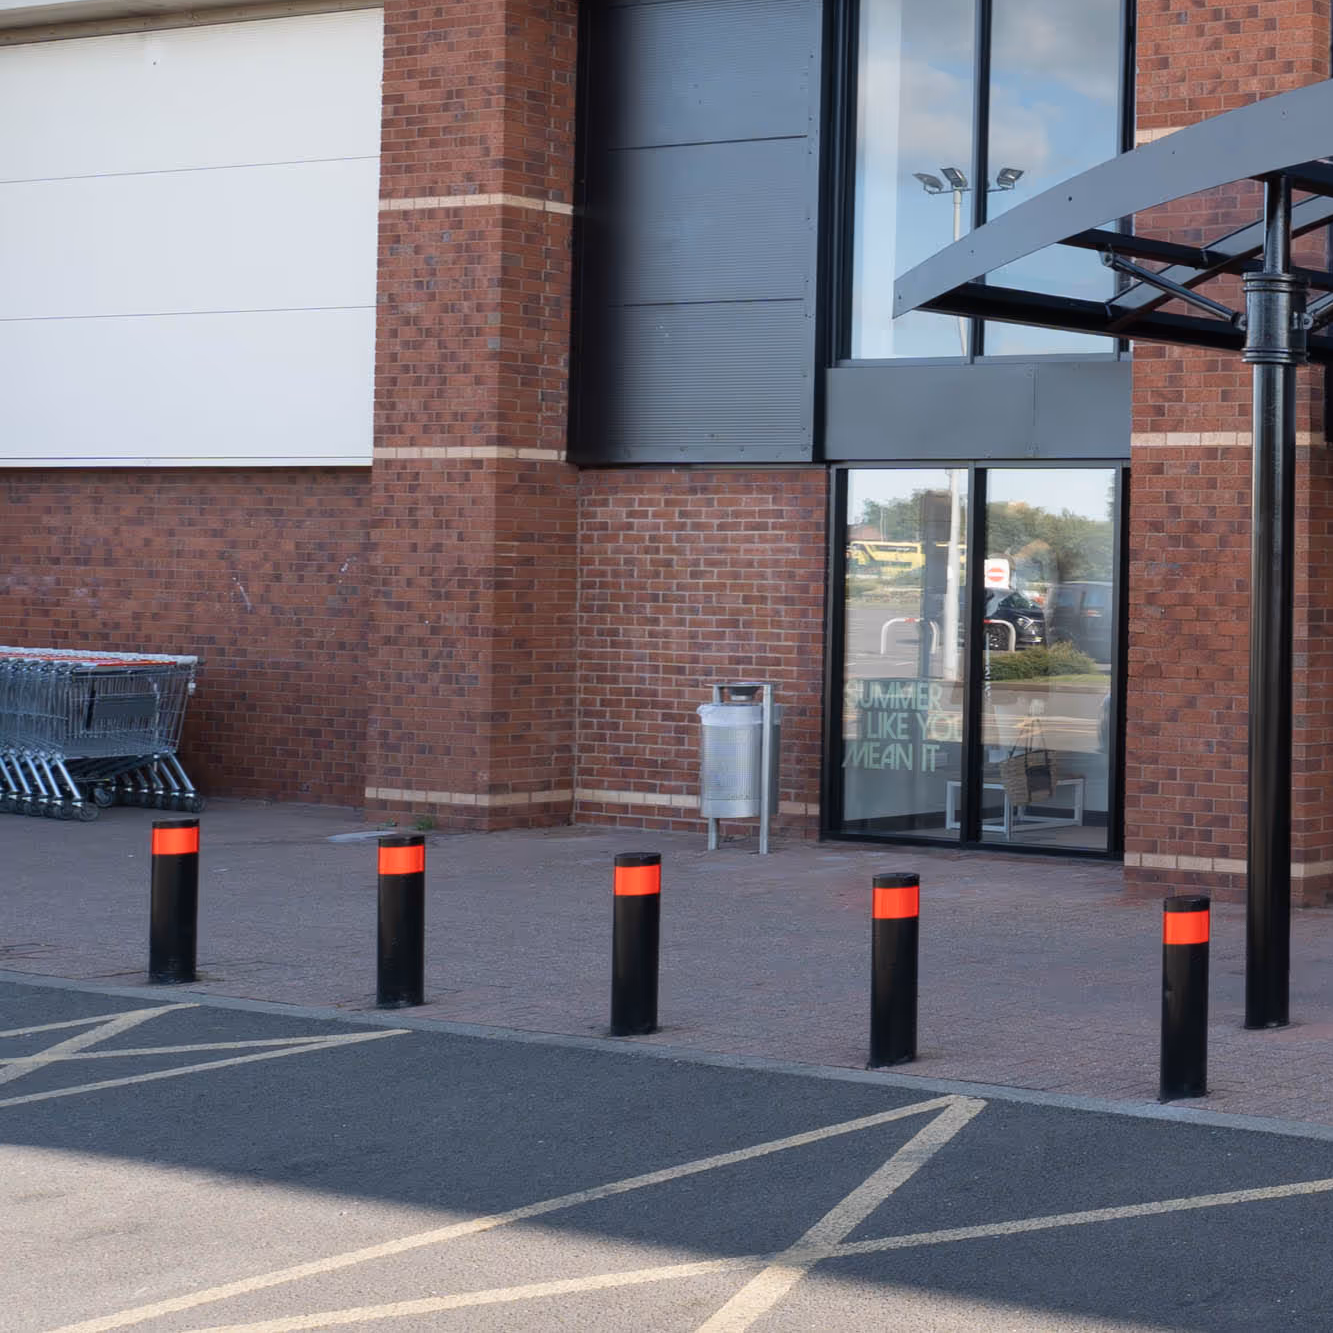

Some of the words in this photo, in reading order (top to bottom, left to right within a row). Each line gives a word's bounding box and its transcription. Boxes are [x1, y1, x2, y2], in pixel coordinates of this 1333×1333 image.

[866, 711, 909, 740] LIKE
[842, 741, 913, 771] MEAN
[921, 744, 940, 773] IT
